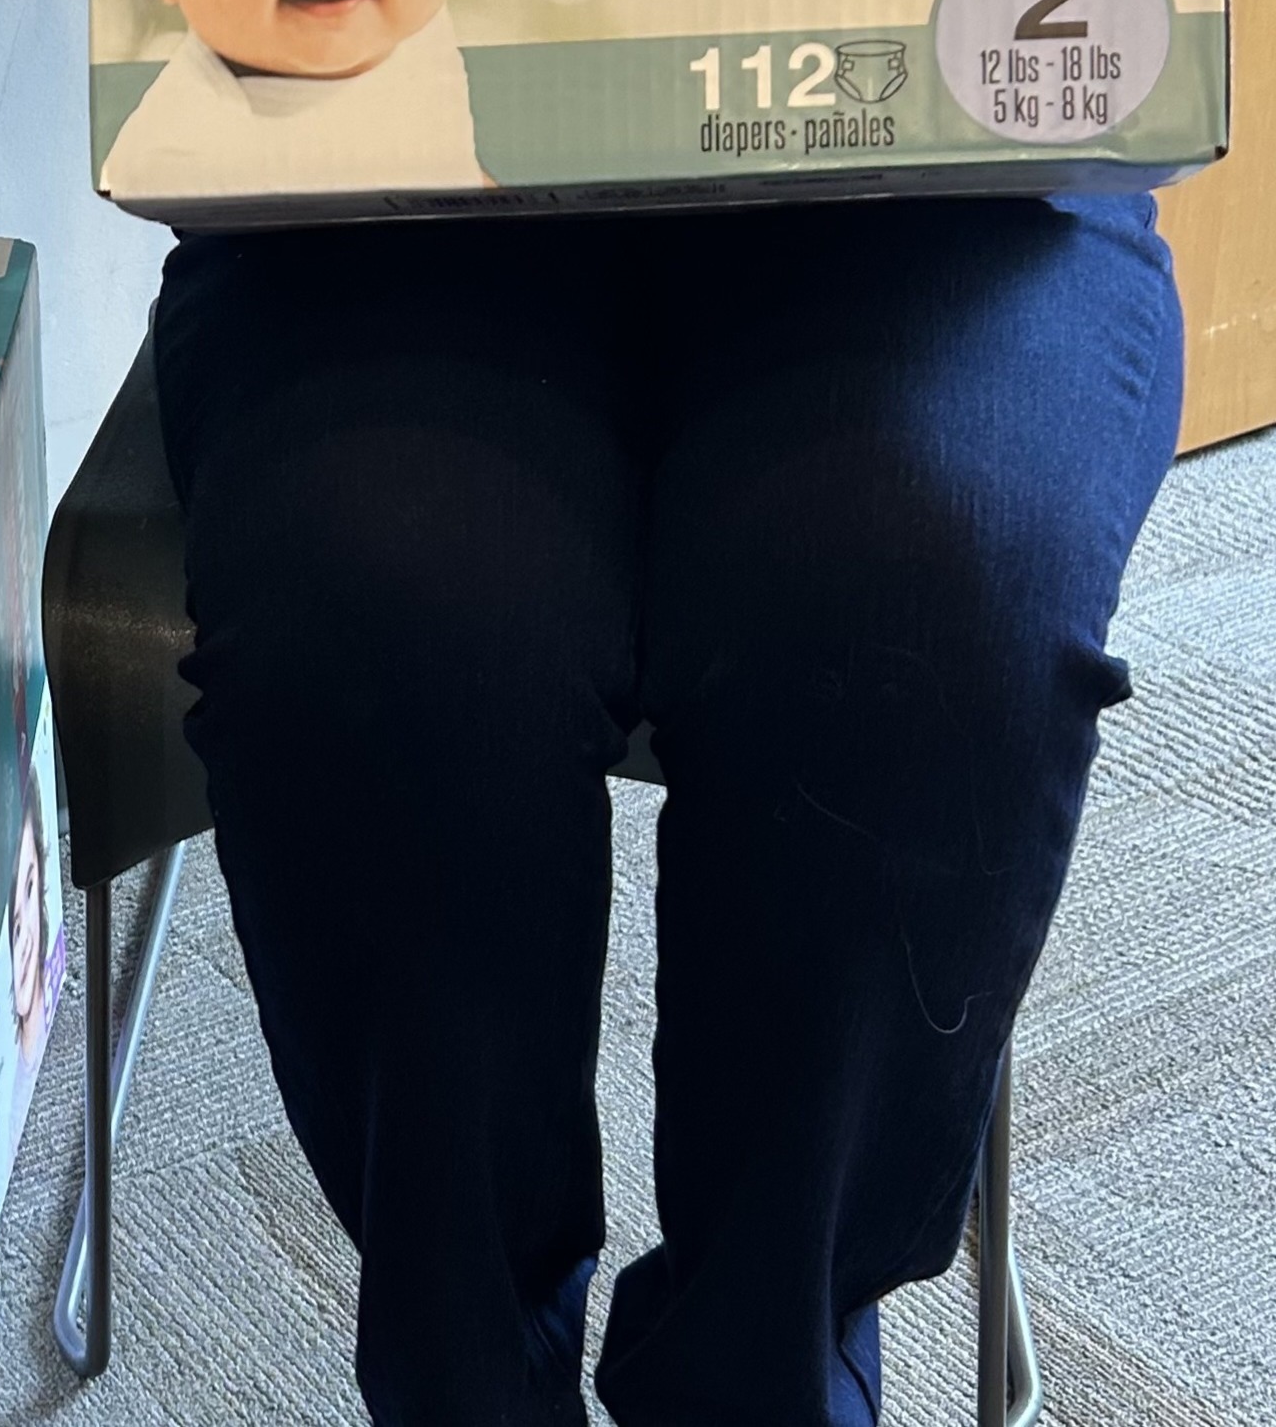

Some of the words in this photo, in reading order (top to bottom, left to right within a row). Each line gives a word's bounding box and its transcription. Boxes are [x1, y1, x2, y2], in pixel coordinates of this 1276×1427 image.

[689, 42, 838, 111] 112
[979, 49, 1002, 85] 12
[1007, 48, 1040, 83] lbs
[1060, 46, 1083, 82] 18
[1089, 45, 1121, 81] lbs
[992, 90, 1008, 124] 5
[1014, 88, 1040, 127] kg
[1061, 88, 1076, 121] 8
[1082, 86, 1108, 125] kg
[700, 115, 786, 158] diapers
[804, 111, 896, 155] pañales
